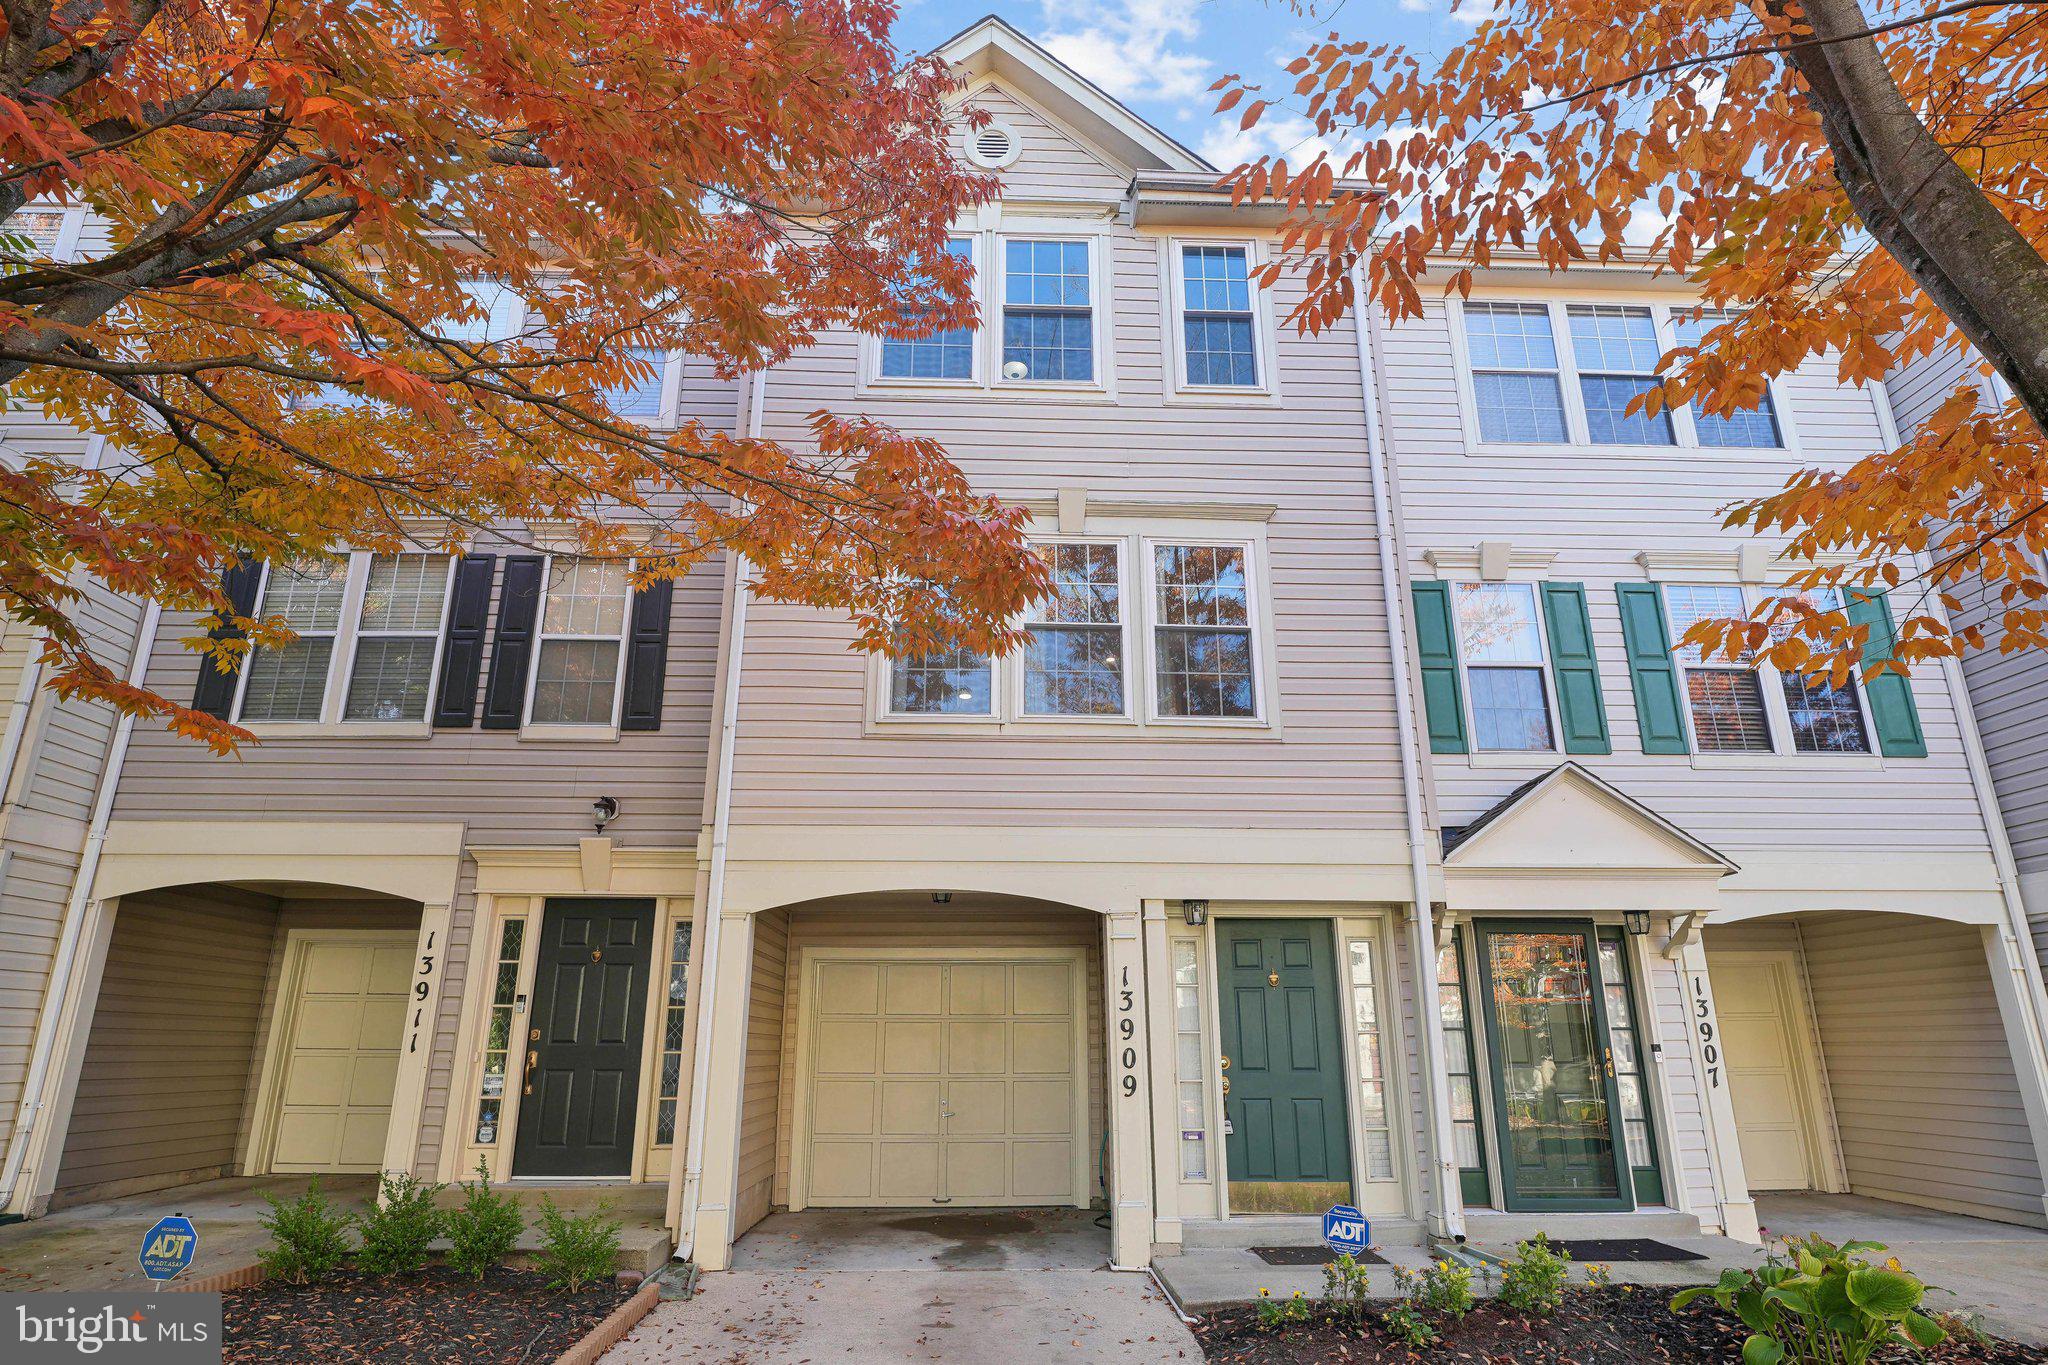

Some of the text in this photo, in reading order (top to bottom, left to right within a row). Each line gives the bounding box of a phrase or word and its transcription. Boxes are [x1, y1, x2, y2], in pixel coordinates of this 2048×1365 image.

[410, 930, 436, 1054] 13911
[1118, 965, 1137, 1098] 13909
[1694, 976, 1719, 1088] 13907
[145, 1234, 193, 1259] ADT
[1328, 1220, 1365, 1242] ADT
